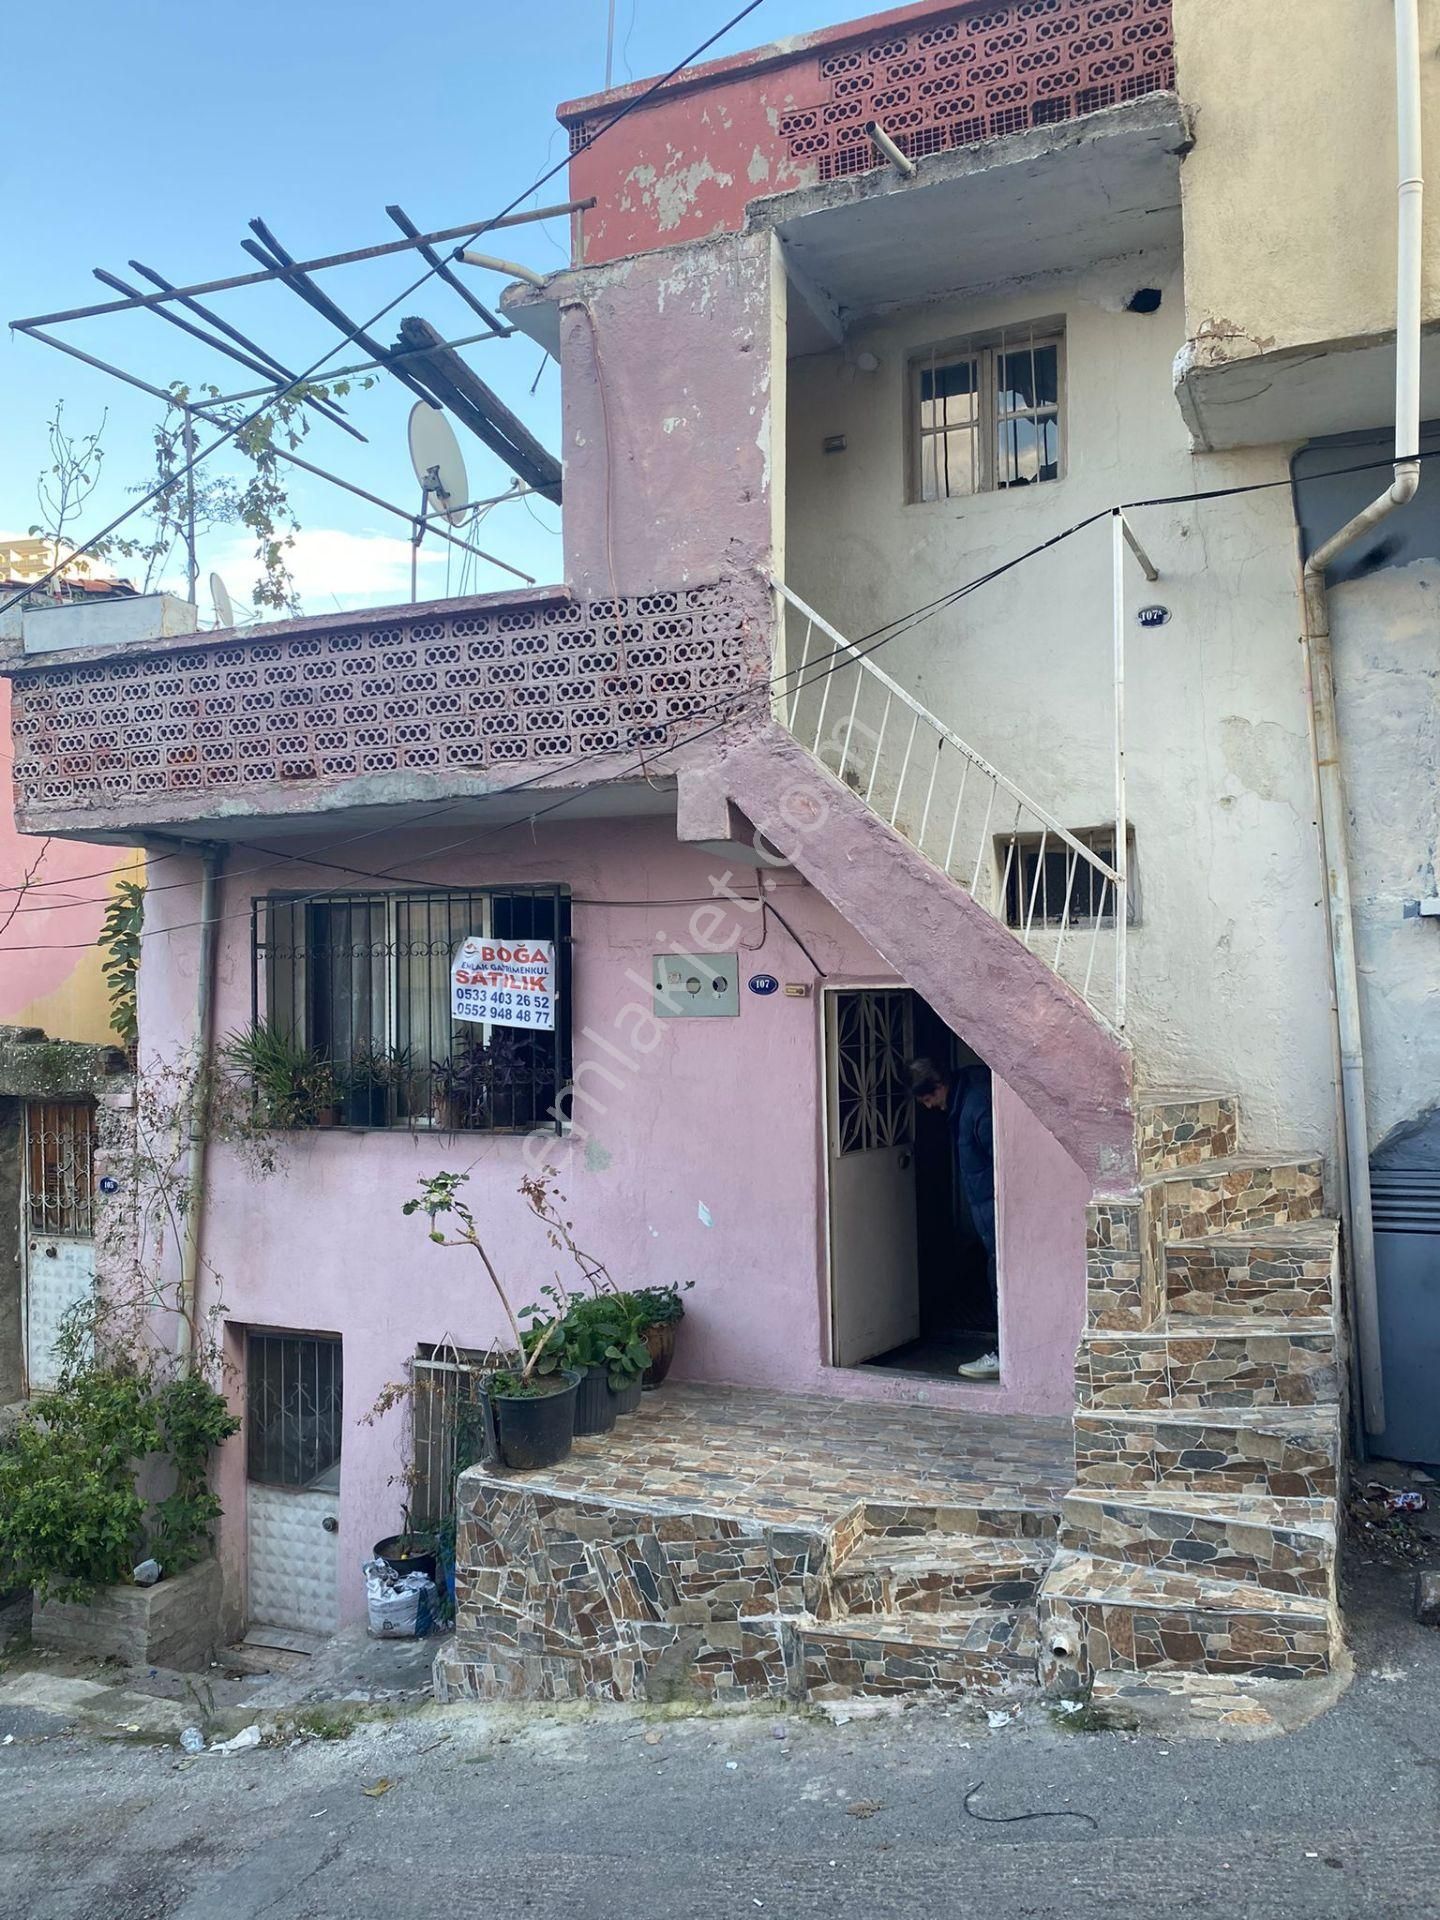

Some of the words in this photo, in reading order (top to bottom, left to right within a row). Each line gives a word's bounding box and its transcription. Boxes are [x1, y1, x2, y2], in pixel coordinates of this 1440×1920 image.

[481, 943, 549, 964] BOĞA
[455, 969, 547, 993] SATILIK
[756, 979, 770, 989] 107
[456, 988, 487, 1001] 0533
[490, 991, 512, 1005] 403
[516, 994, 531, 1007] 26
[534, 996, 549, 1009] 52
[457, 1002, 487, 1017] 0552
[490, 1006, 512, 1020] 948
[516, 1009, 531, 1022] 48
[535, 1011, 550, 1024] 77
